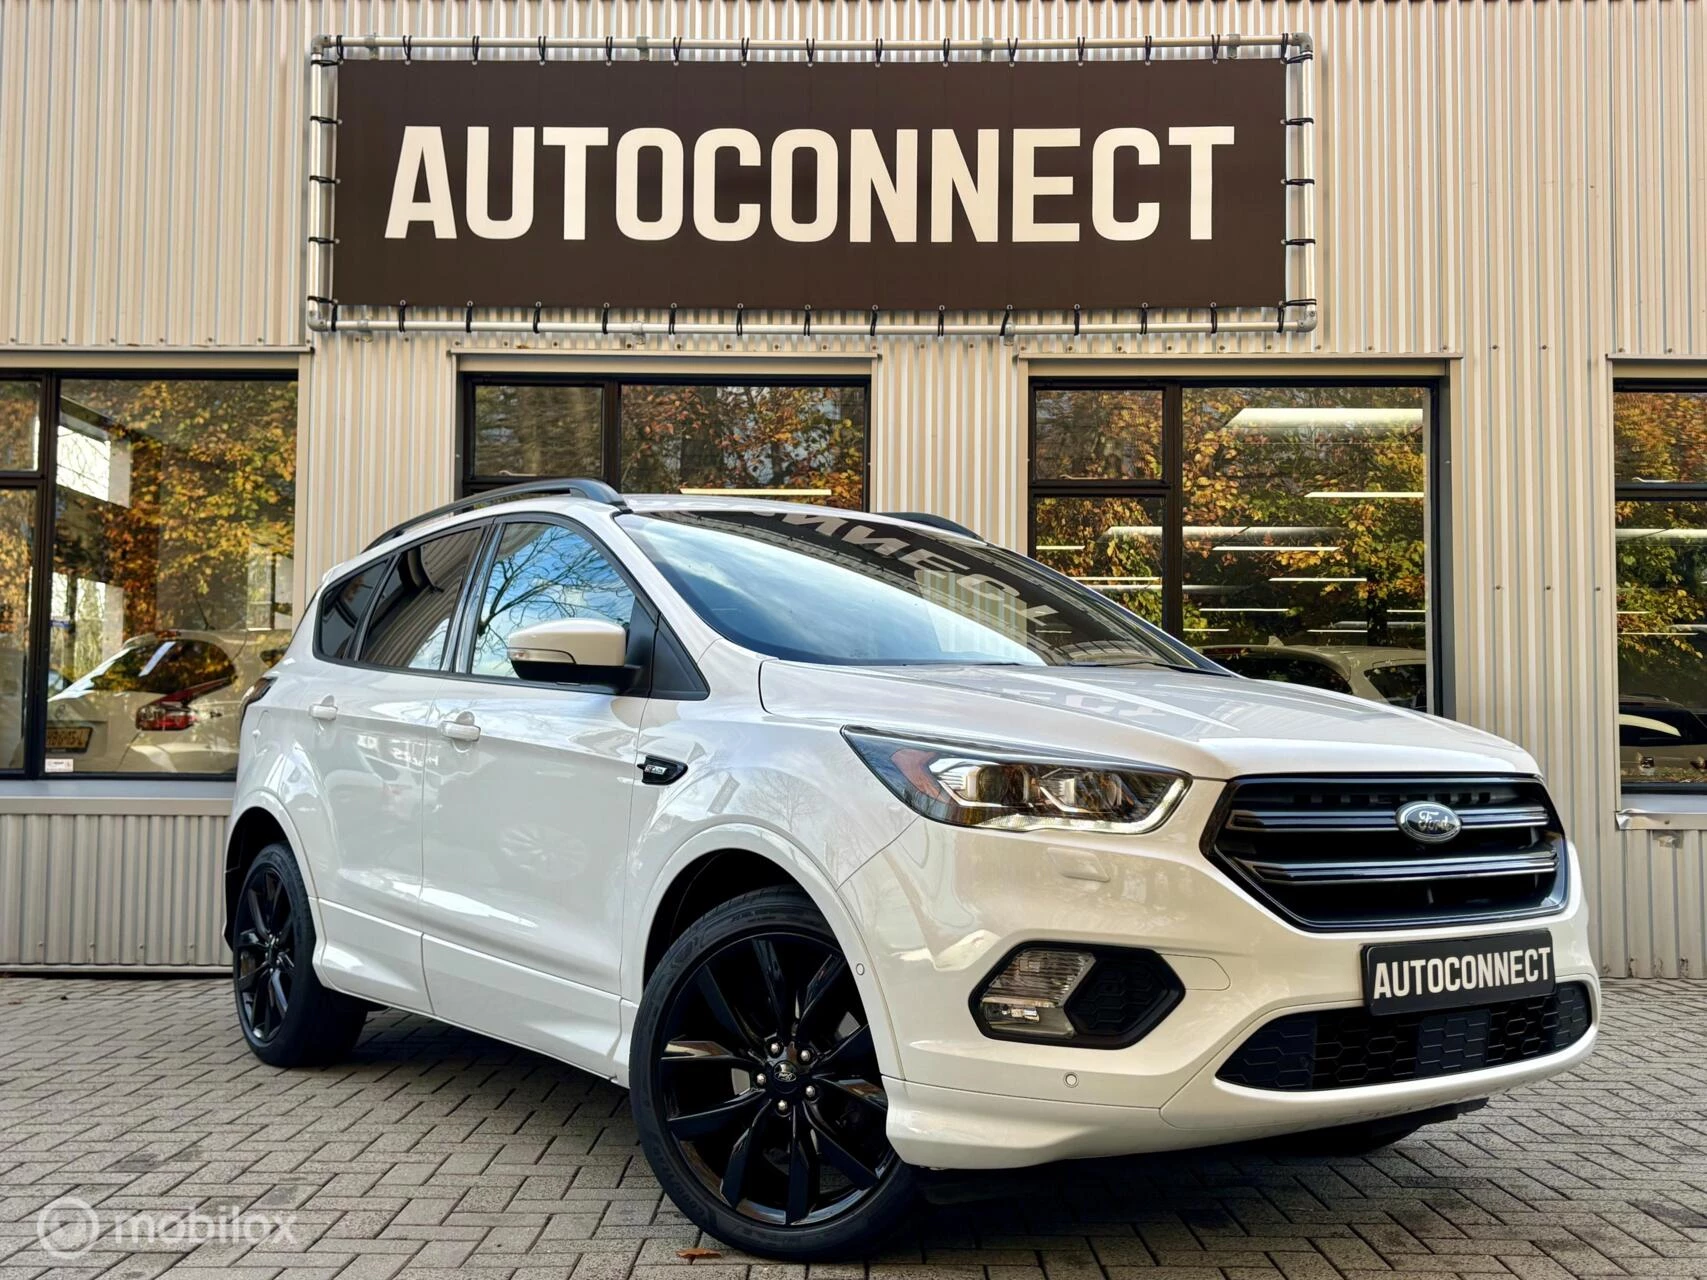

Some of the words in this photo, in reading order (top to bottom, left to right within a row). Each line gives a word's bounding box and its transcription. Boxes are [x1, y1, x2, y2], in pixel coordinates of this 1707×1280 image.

[385, 125, 1234, 242] AUTOCONNECT
[1418, 810, 1453, 832] Ford
[1373, 947, 1551, 1000] AUTOCONNECT
